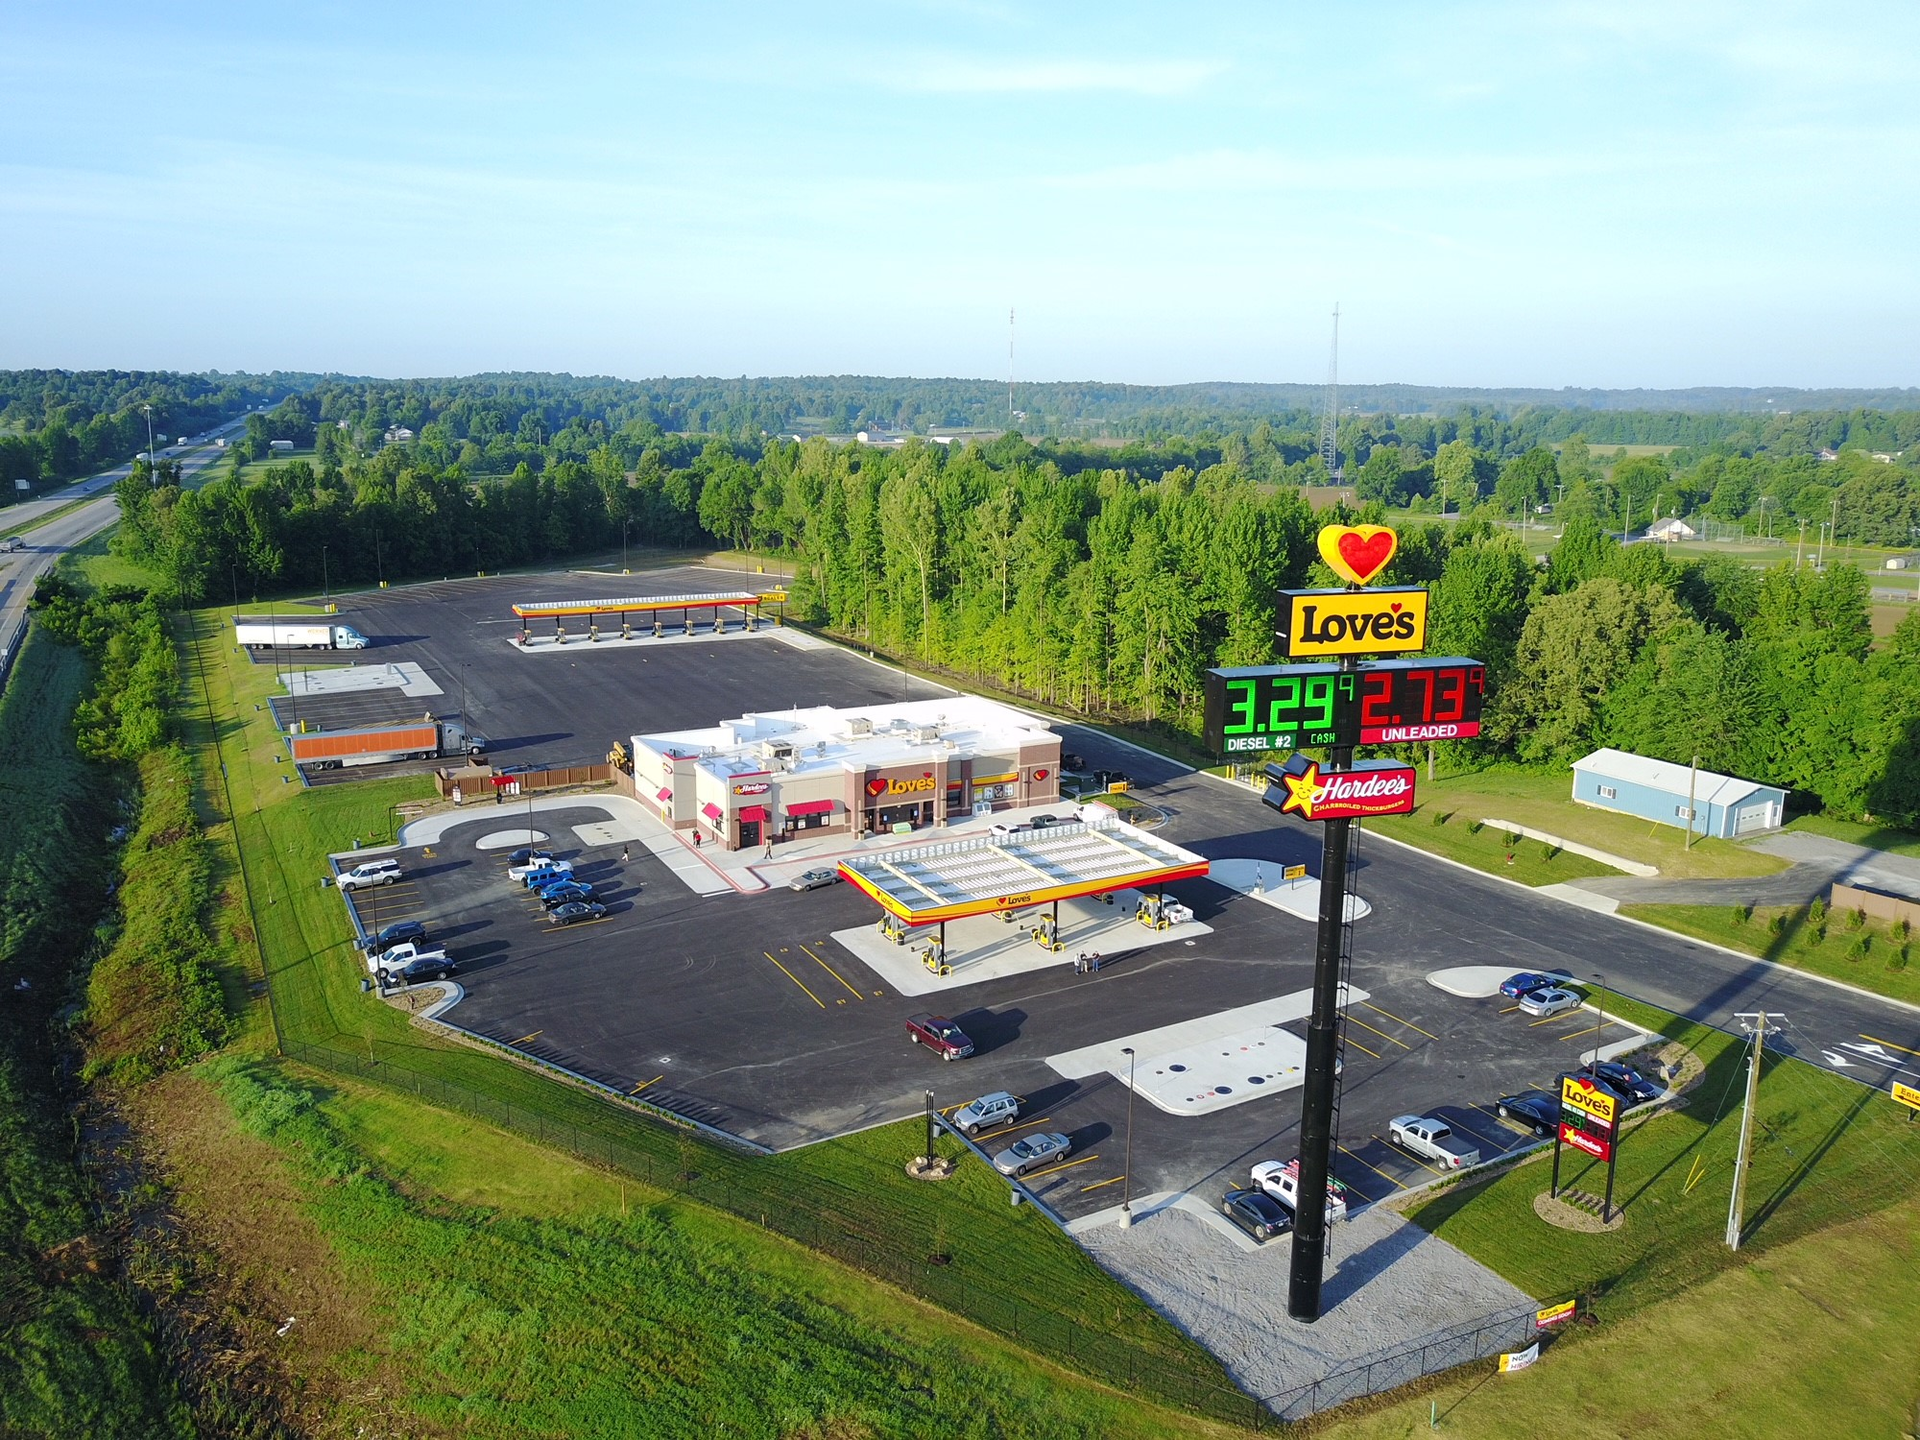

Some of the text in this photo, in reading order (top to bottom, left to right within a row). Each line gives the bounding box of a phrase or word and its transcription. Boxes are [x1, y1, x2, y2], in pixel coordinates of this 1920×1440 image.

[1300, 603, 1415, 644] Love's
[1310, 732, 1336, 744] CASH
[1382, 724, 1457, 741] UNLEADED
[1227, 735, 1292, 751] DIESEL #2
[887, 772, 936, 796] Love's
[1310, 774, 1411, 803] Hardee's
[1313, 799, 1405, 812] CHARBROILED THICKBURGERS
[1008, 893, 1031, 905] Love's
[1565, 1084, 1611, 1116] Love's
[1901, 1087, 1920, 1101] Ente
[1511, 1353, 1528, 1362] NOW
